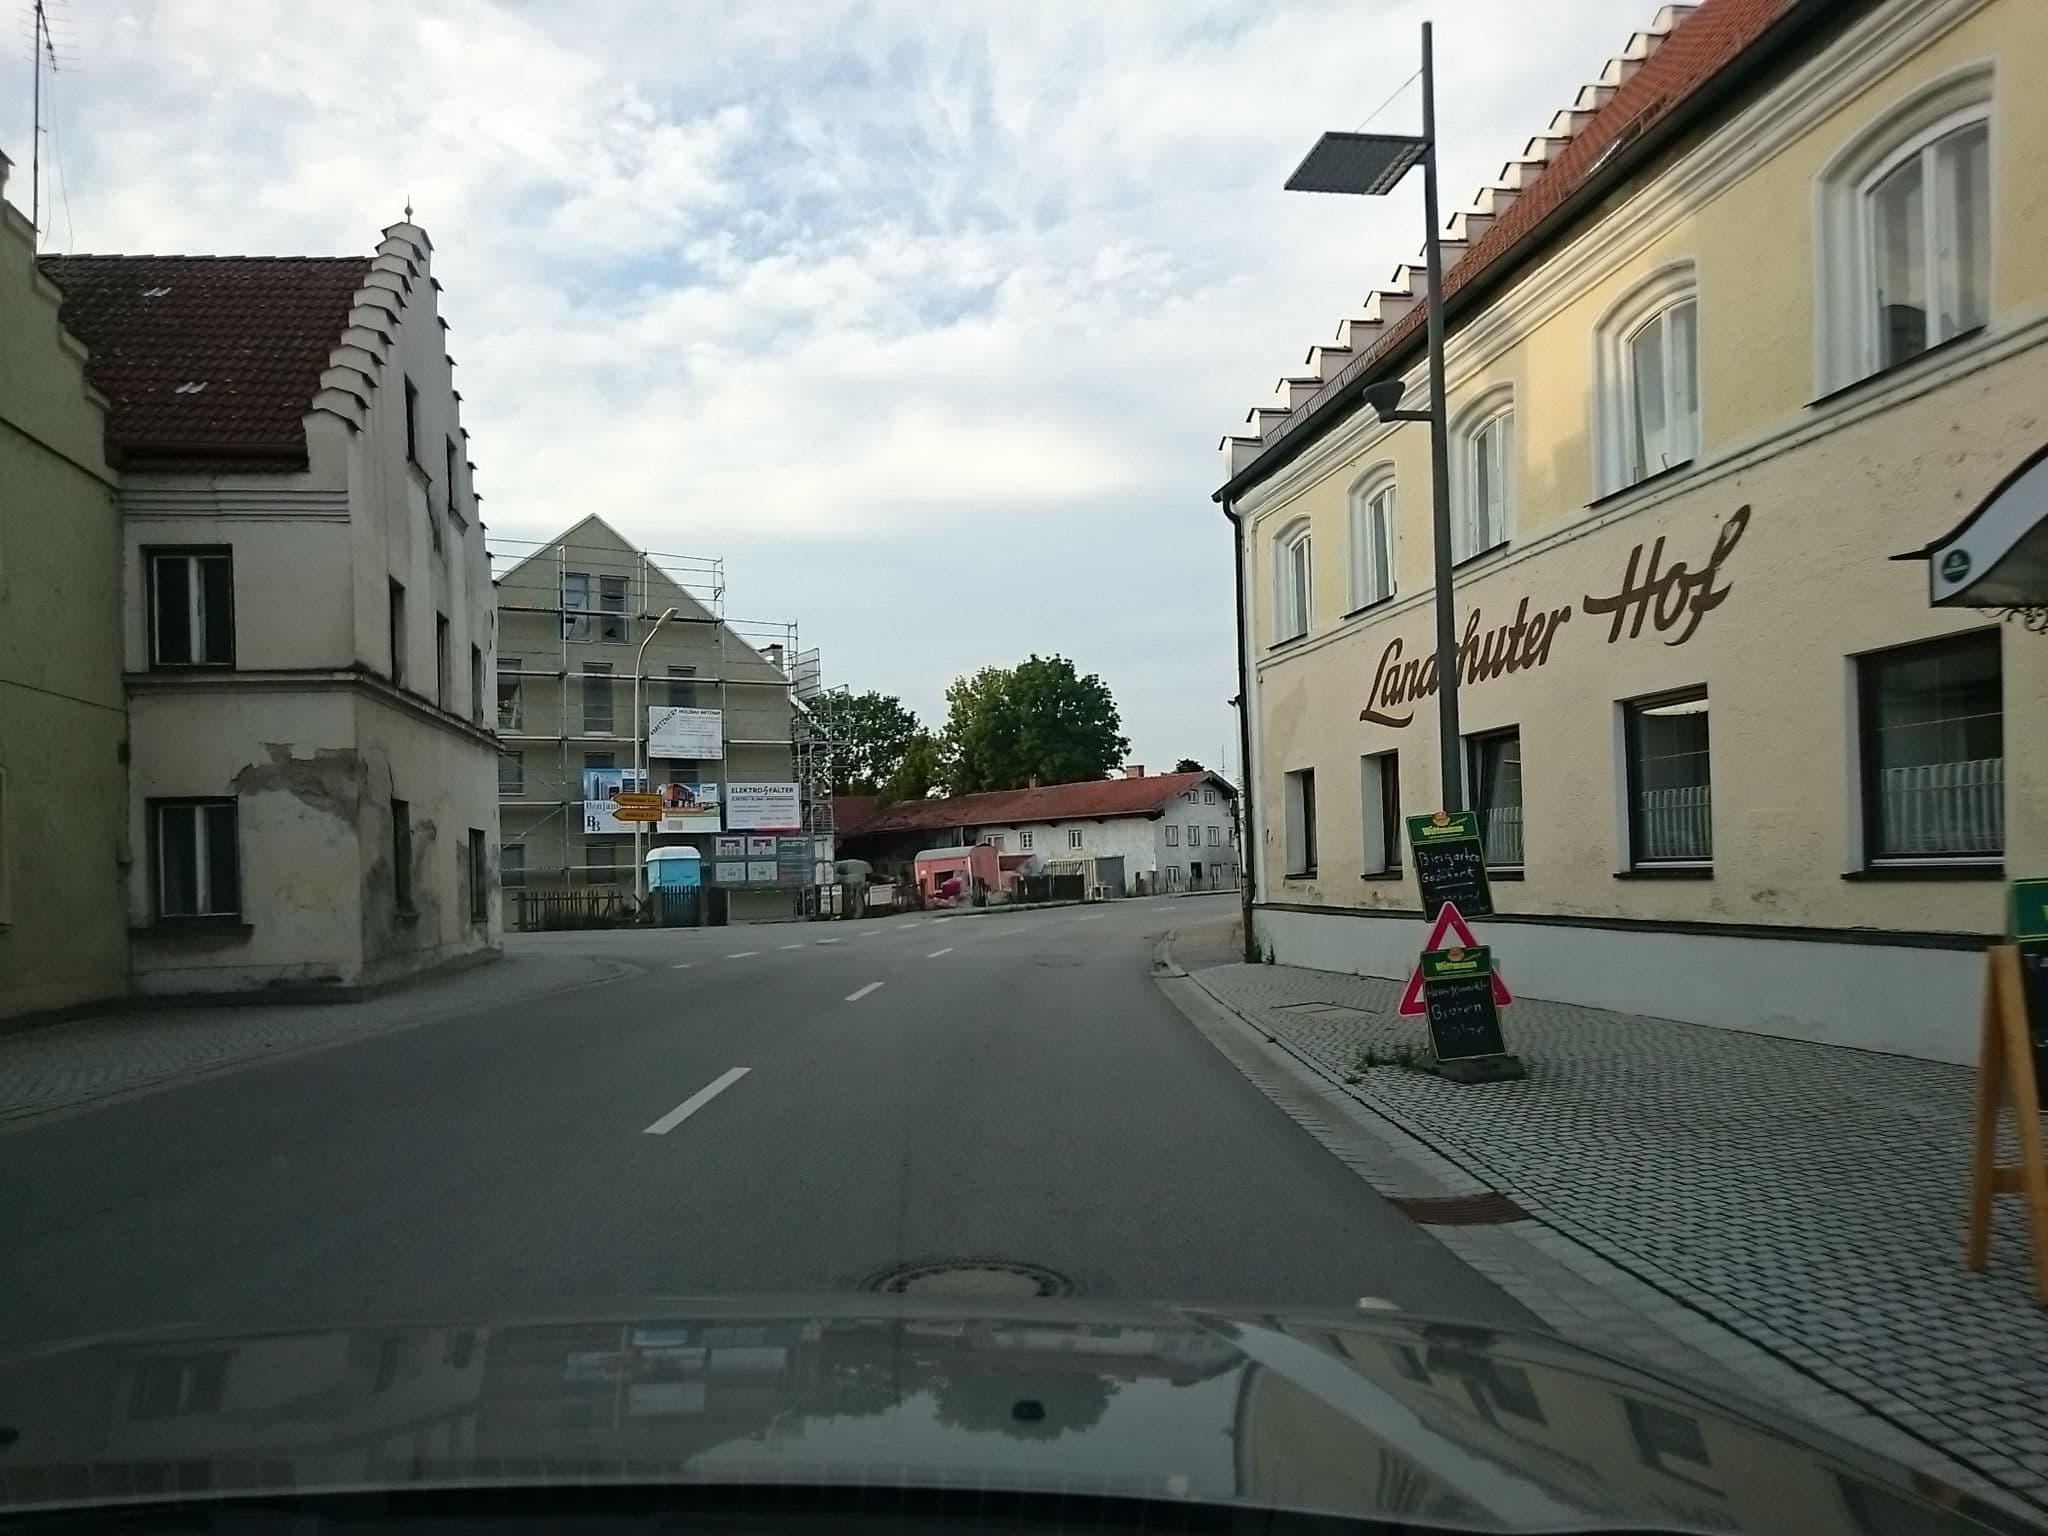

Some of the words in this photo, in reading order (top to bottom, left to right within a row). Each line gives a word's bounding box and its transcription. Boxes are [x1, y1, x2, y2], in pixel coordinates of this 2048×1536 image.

[1360, 597, 1572, 728] Landhuter
[1583, 504, 1752, 647] Hof
[731, 786, 763, 794] ELEKTRO
[769, 786, 794, 794] FALTER
[586, 801, 619, 811] Benjam
